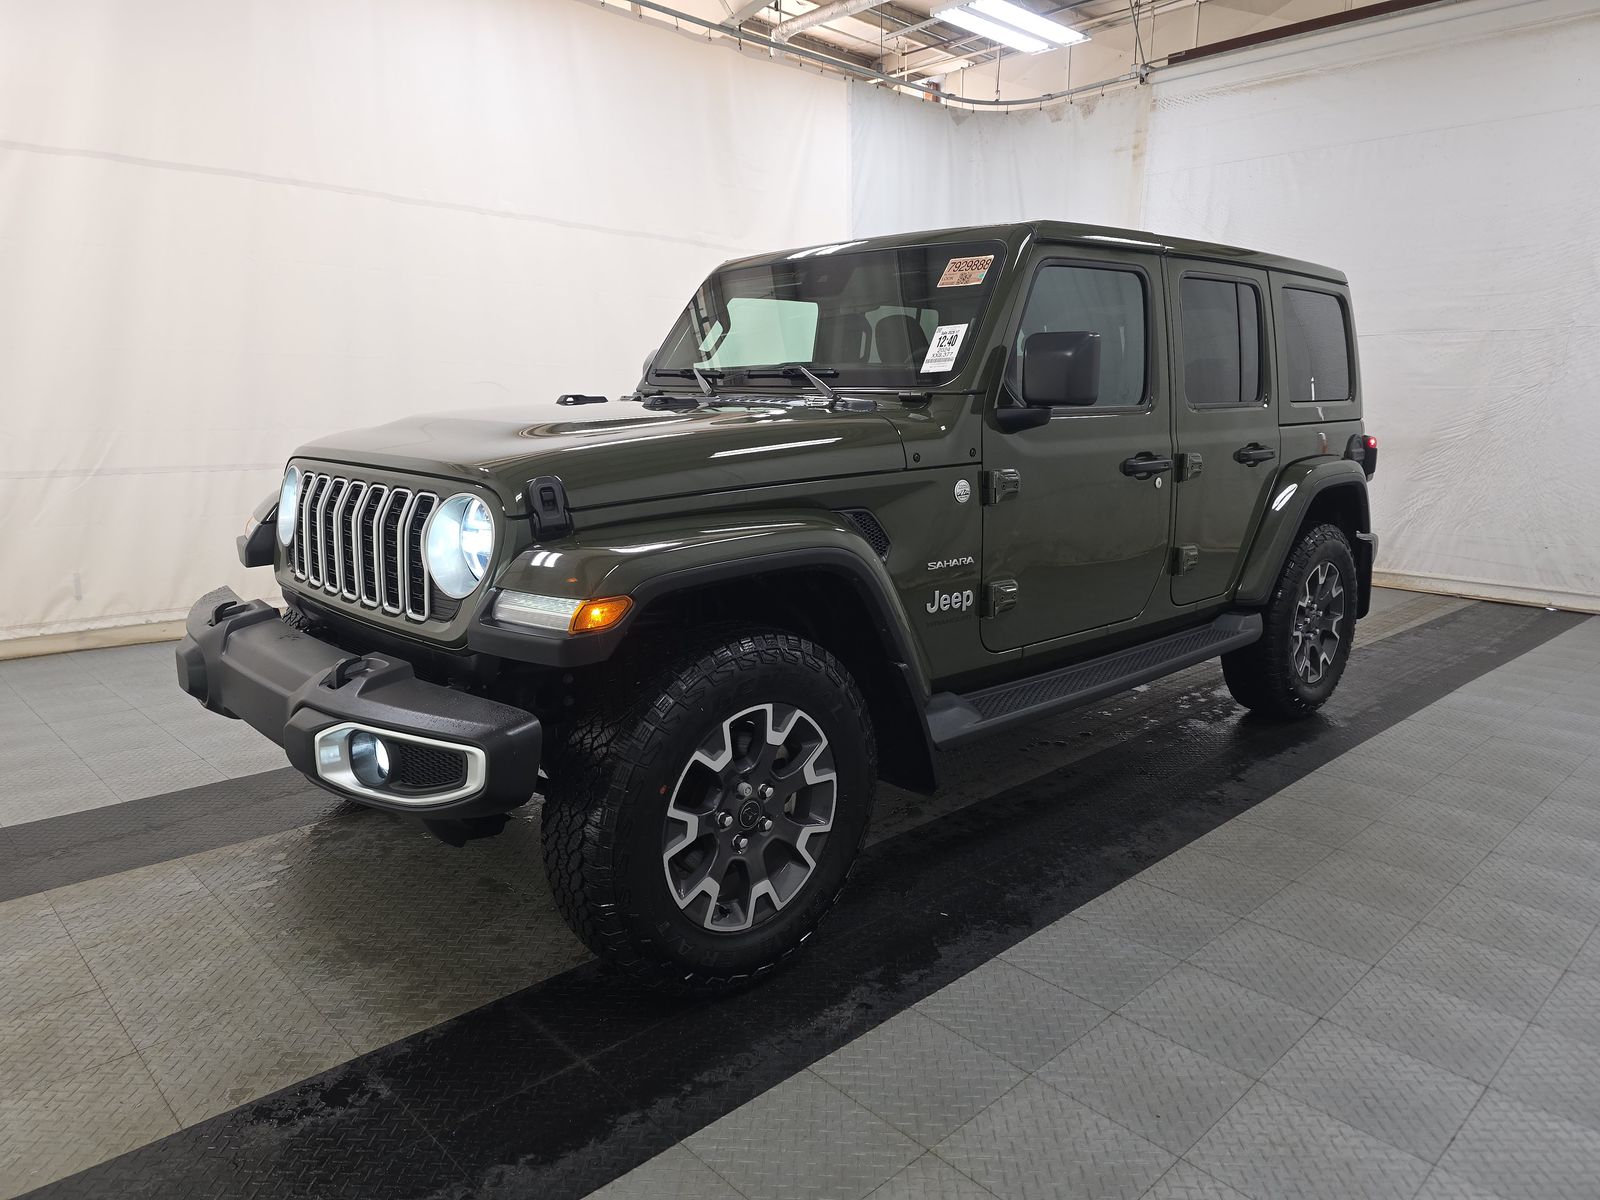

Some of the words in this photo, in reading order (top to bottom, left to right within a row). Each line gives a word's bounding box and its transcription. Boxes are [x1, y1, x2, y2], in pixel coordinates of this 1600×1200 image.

[947, 258, 992, 272] 7929888
[936, 334, 958, 348] 12:40
[927, 556, 975, 570] SAHARA
[926, 589, 974, 613] Jeep
